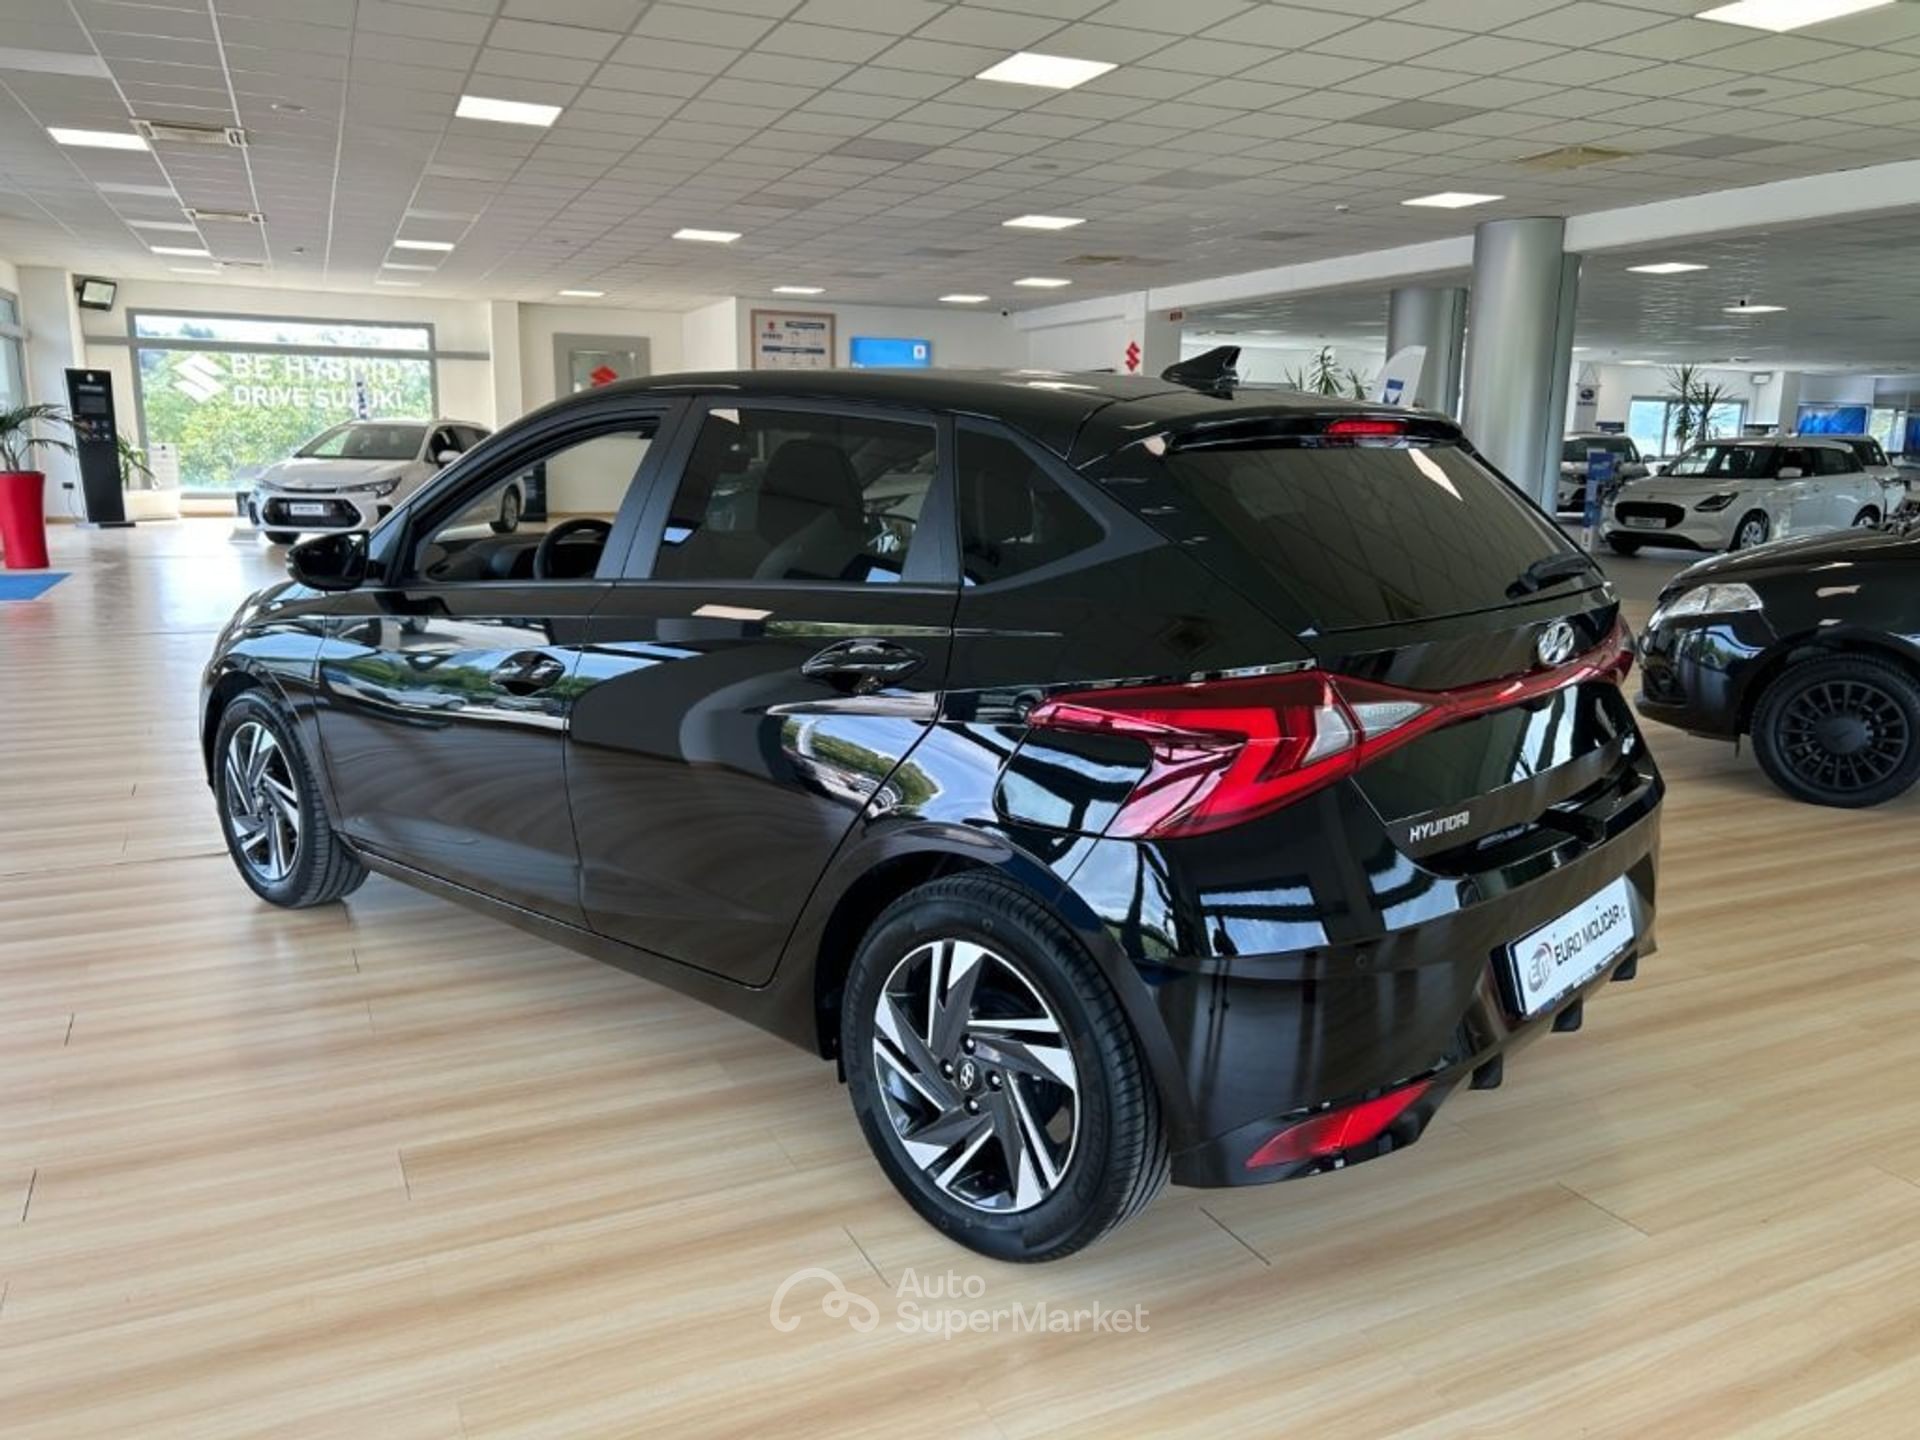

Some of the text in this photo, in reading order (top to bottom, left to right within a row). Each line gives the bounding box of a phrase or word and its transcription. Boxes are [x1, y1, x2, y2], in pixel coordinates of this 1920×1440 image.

[231, 354, 272, 379] BE
[233, 384, 310, 408] DRIVE
[315, 386, 402, 410] SUUKI
[1409, 810, 1470, 843] HYUNDAI
[1553, 931, 1583, 967] EURO
